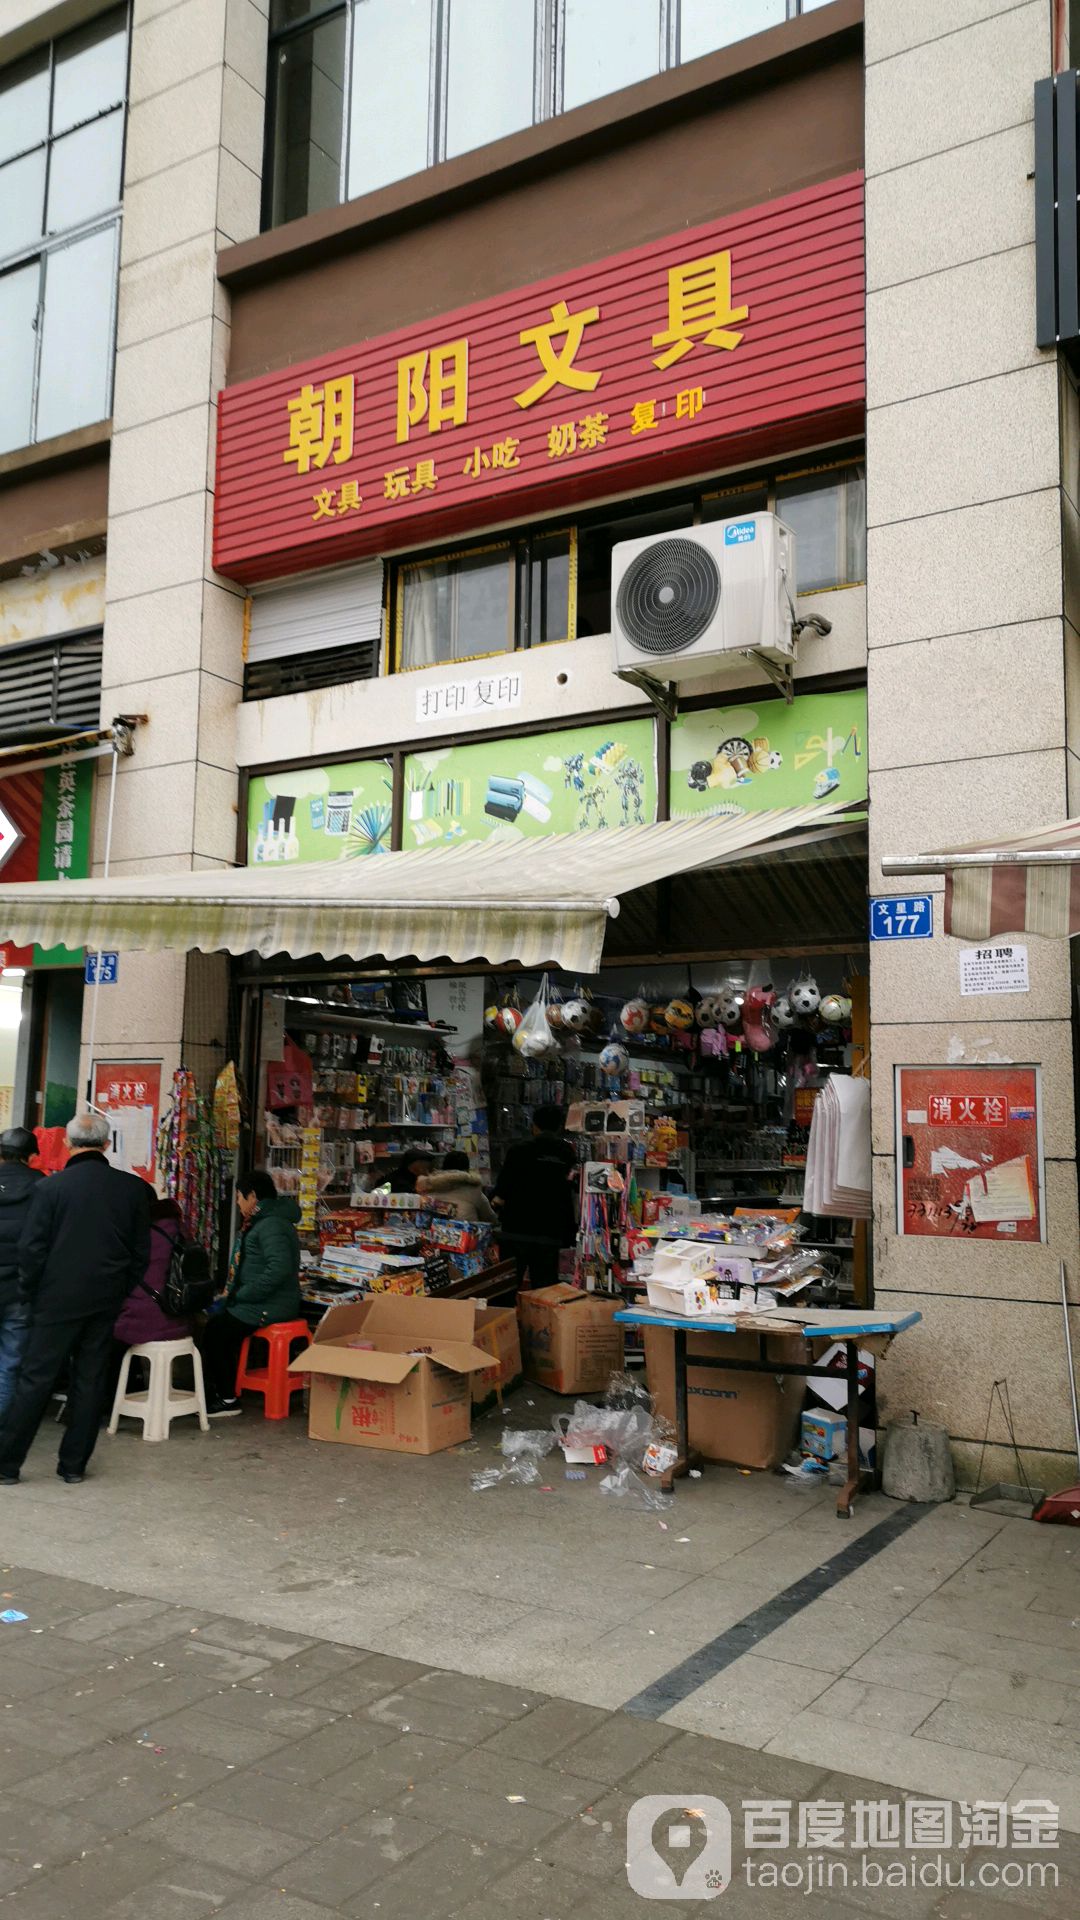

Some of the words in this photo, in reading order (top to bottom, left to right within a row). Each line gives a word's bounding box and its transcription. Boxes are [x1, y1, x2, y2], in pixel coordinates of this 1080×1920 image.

[284, 250, 749, 474] 朝阳文具
[312, 480, 362, 520] 文具
[384, 459, 438, 499] 玩具
[463, 437, 520, 478] 小吃
[548, 412, 608, 458] 奶茶
[631, 386, 704, 435] 复印
[422, 685, 465, 716] 打印
[474, 676, 519, 708] 复印
[878, 901, 925, 915] 文星路
[883, 915, 920, 935] 177
[974, 947, 1013, 960] 招聘
[932, 1097, 1003, 1122] 消火栓
